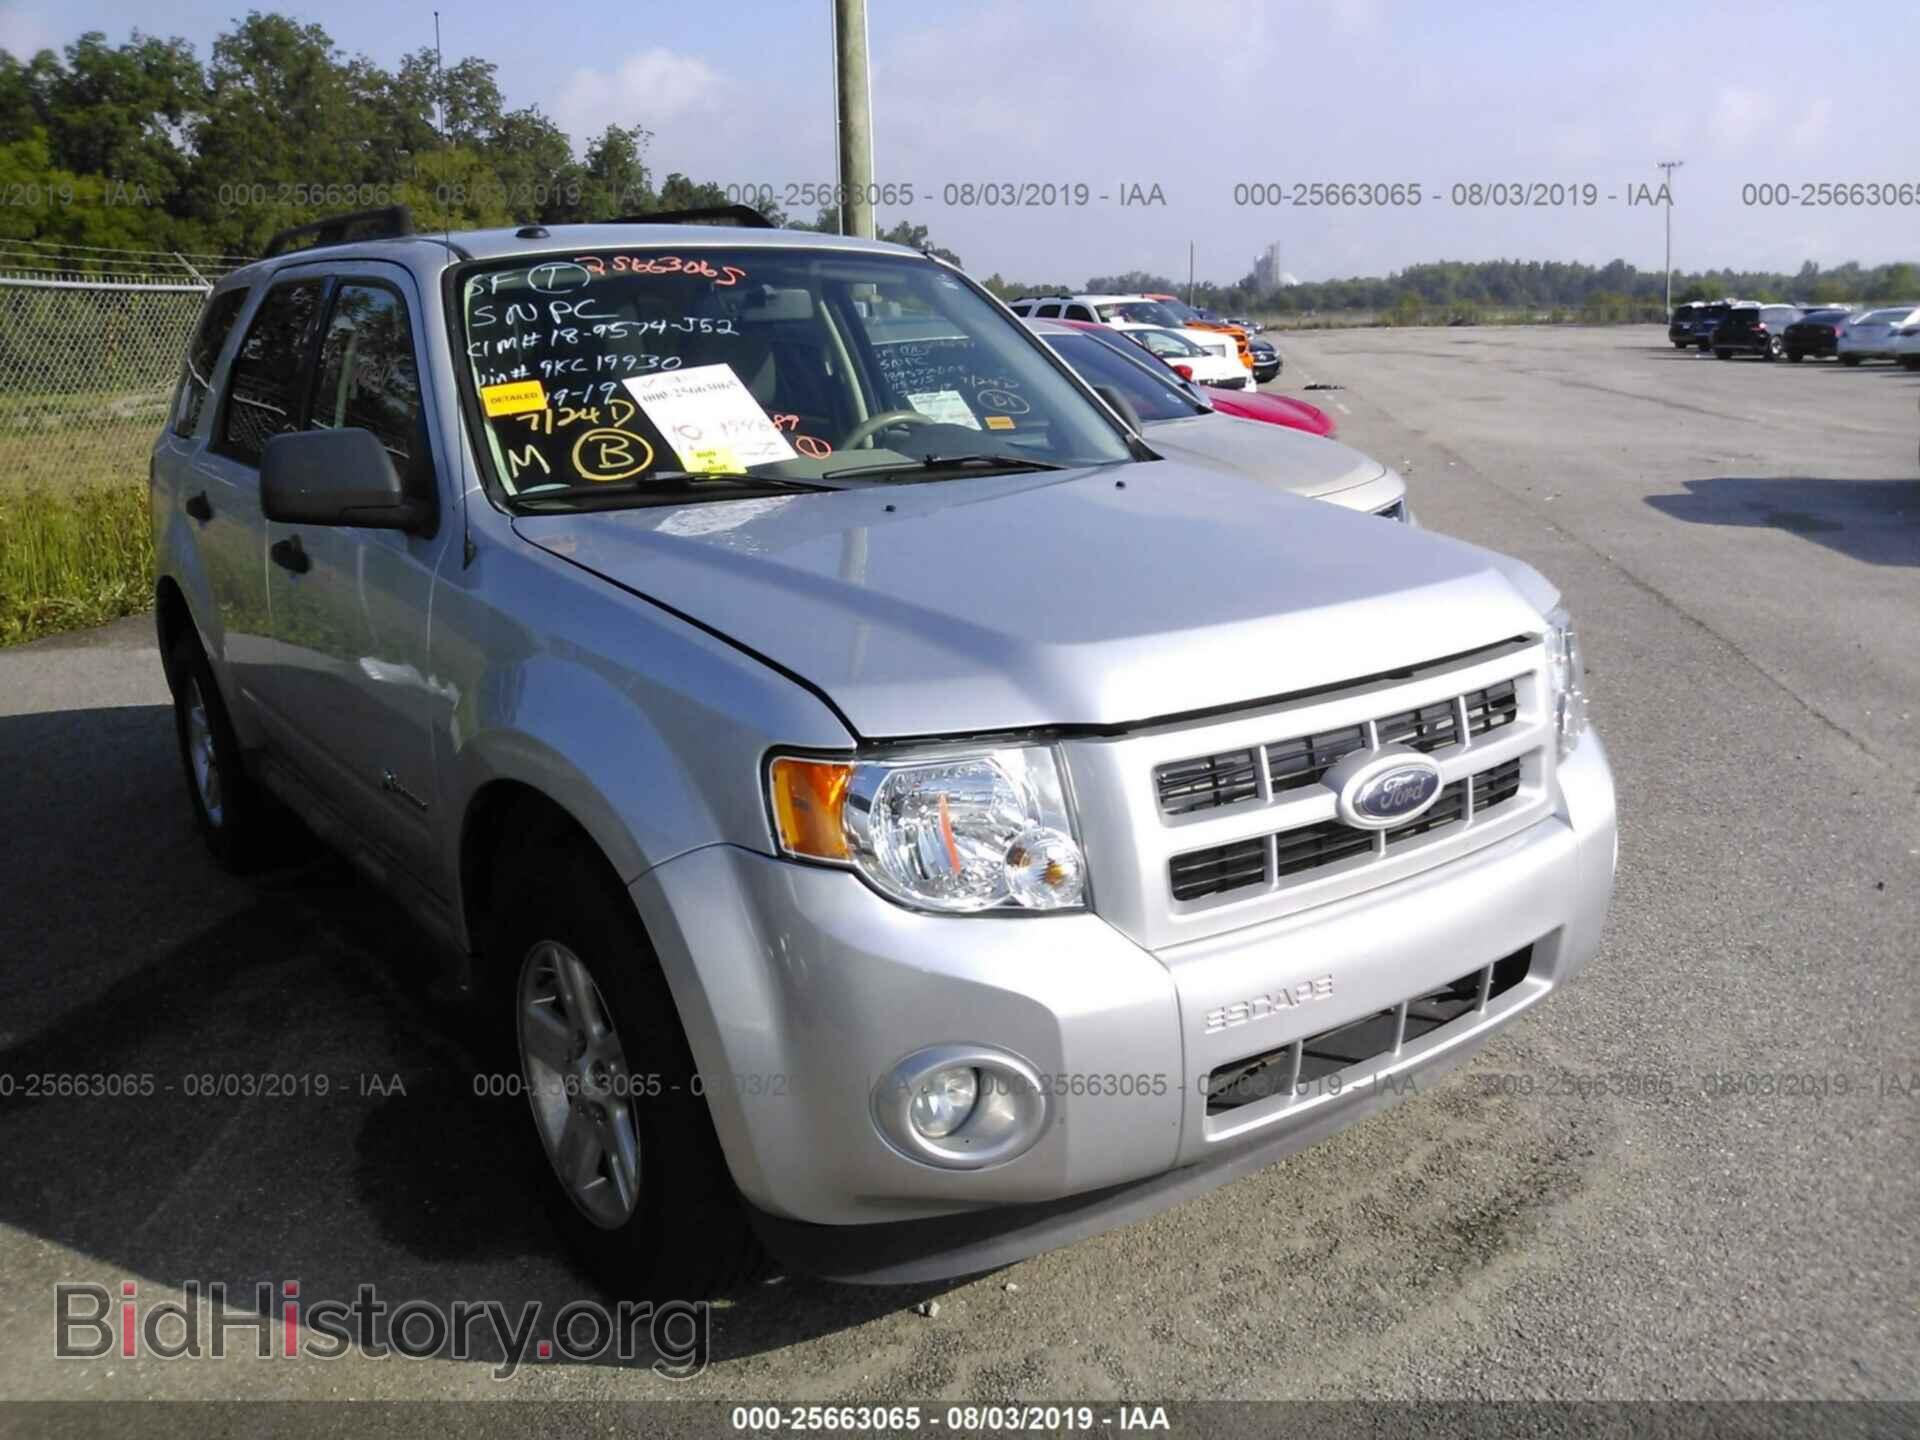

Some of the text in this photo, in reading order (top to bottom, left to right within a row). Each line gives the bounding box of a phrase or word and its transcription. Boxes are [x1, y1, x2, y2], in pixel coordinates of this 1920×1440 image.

[574, 257, 746, 285] 25663065
[490, 392, 538, 405] DETAILED
[507, 443, 551, 478] M
[1379, 771, 1427, 811] Ford
[1204, 973, 1334, 1036] ESCAPE
